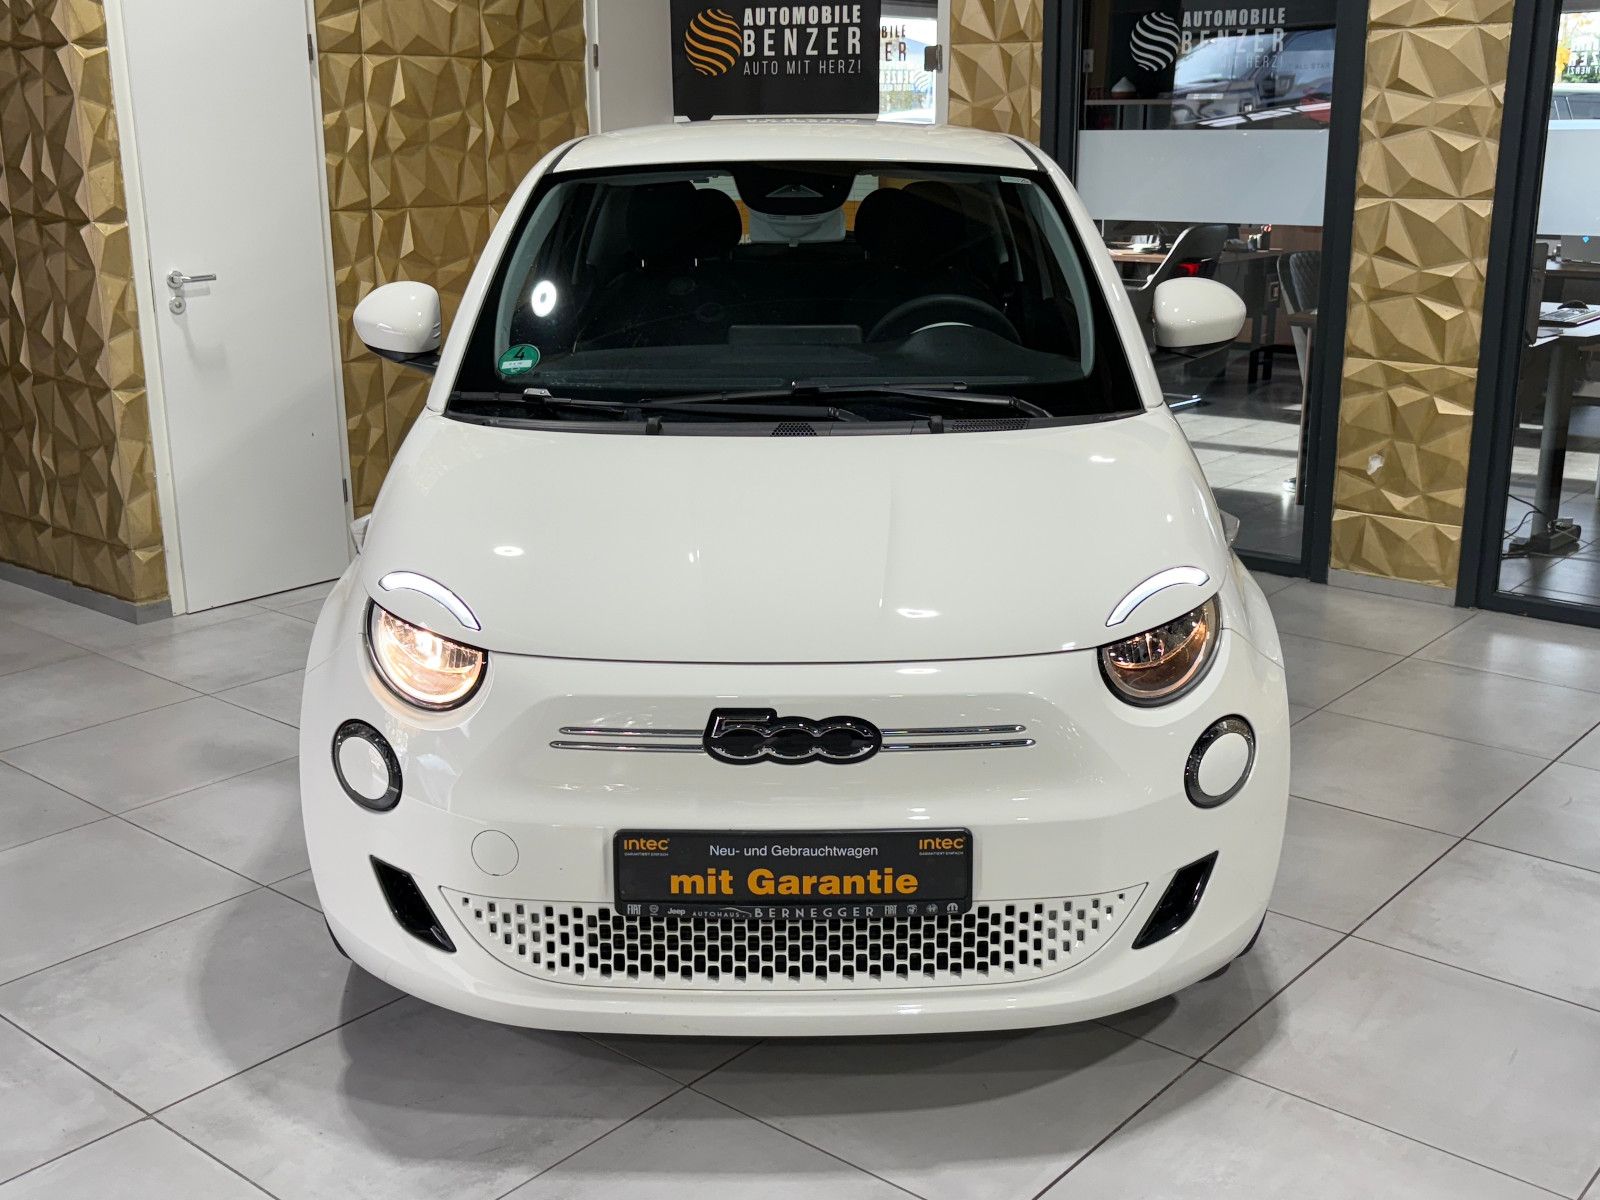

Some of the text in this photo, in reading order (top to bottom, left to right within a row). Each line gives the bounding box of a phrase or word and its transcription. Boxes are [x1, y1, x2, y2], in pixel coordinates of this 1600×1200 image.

[743, 5, 861, 26] AUTOMOBILE
[1182, 7, 1286, 27] AUTOMOBILE
[881, 25, 906, 38] BILE
[743, 27, 861, 57] BENZER
[743, 59, 861, 76] AUTO MIT HERZ!
[703, 707, 882, 765] 500
[623, 838, 669, 850] intec
[919, 838, 964, 850] intec
[709, 845, 879, 860] Neu- und Gebrauchtwagen
[670, 868, 919, 896] mit Garantie
[627, 904, 641, 915] FIAT
[667, 907, 686, 916] Jeep
[754, 907, 874, 918] BERNEGGER
